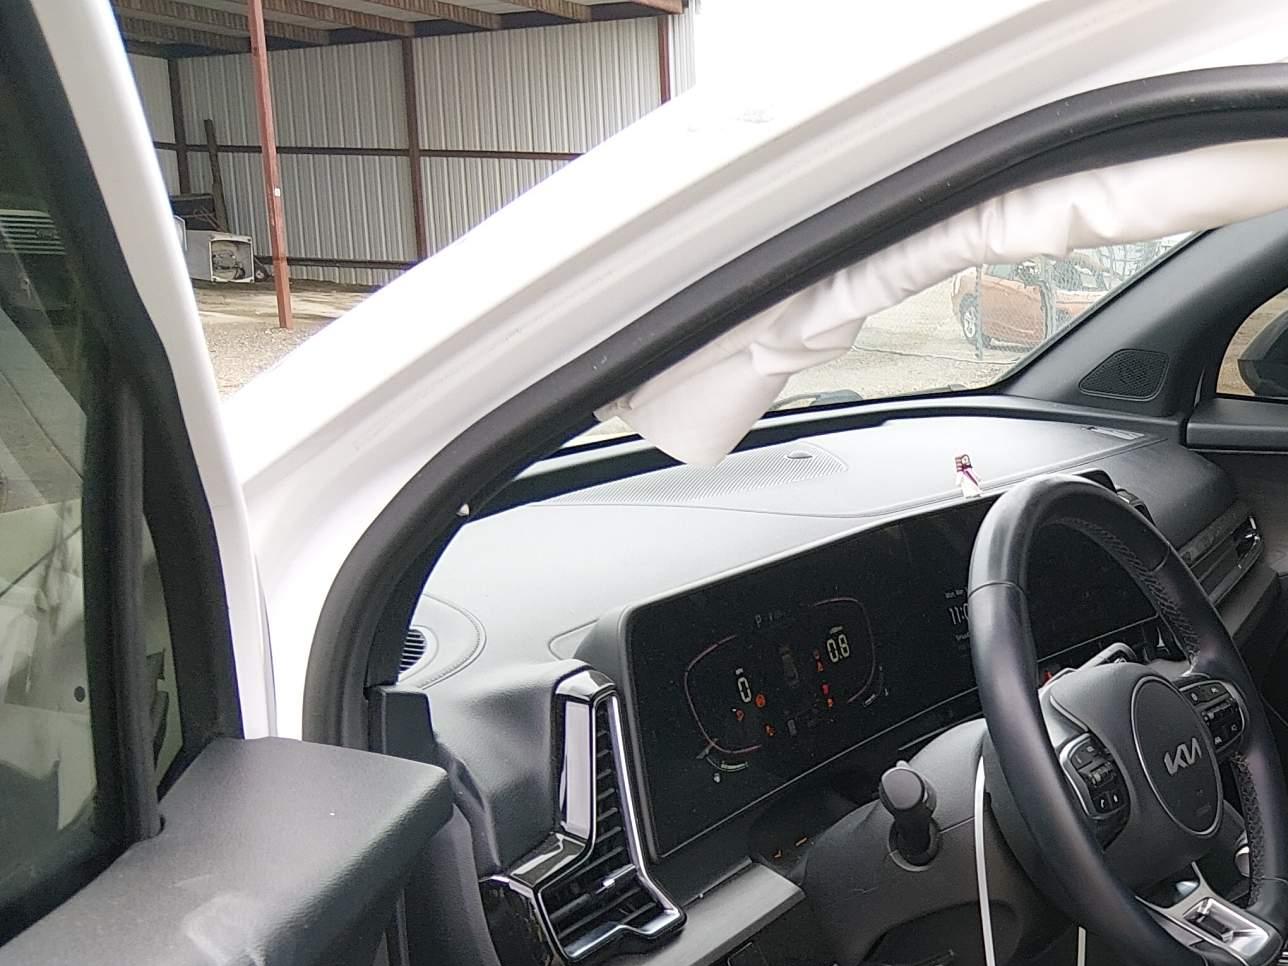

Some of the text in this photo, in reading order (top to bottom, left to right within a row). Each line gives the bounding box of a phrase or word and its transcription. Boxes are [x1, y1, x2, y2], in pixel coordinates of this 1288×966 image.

[826, 633, 850, 663] 0.8
[737, 676, 752, 703] 0
[1163, 737, 1202, 776] KIA
